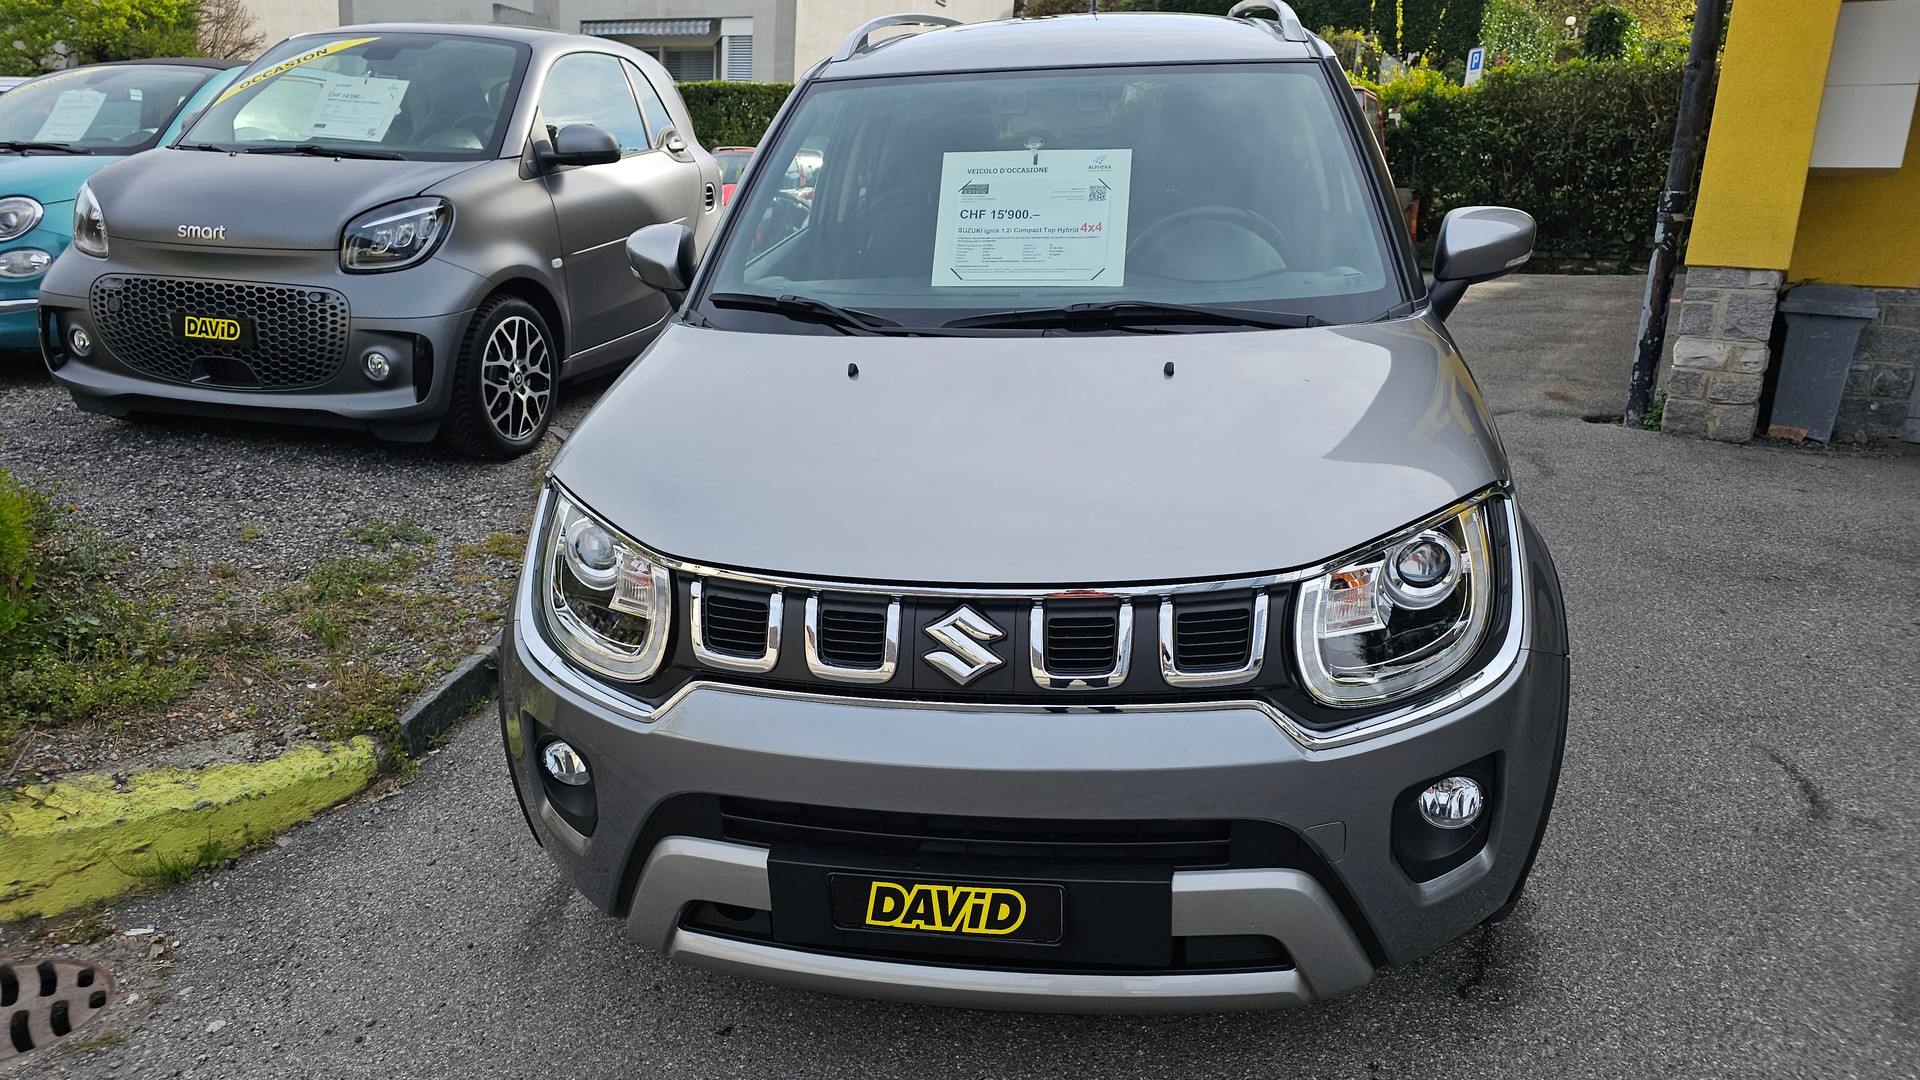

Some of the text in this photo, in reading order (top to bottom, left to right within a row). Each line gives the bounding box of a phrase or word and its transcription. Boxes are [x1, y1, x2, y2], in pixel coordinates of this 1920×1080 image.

[1472, 53, 1480, 69] P
[239, 48, 329, 90] OCCASION
[999, 166, 1049, 174] D'OCCASIONE
[960, 209, 987, 219] CHF
[177, 224, 227, 240] smart
[984, 227, 999, 235] Ignis
[1013, 227, 1042, 235] Compact
[1080, 222, 1103, 233] 4x4
